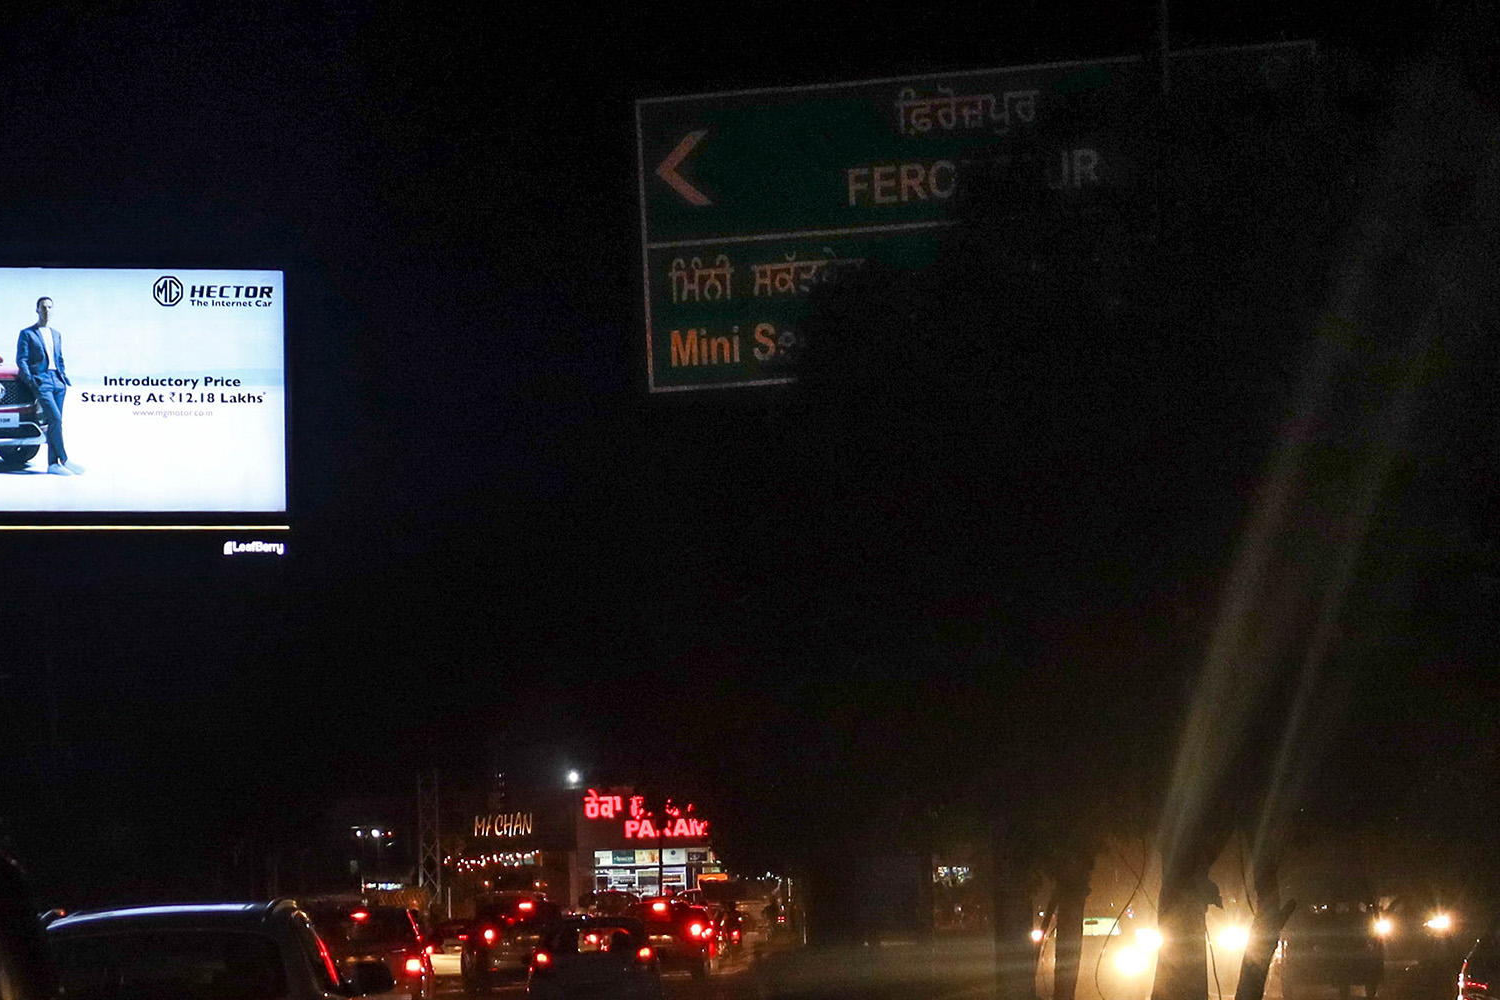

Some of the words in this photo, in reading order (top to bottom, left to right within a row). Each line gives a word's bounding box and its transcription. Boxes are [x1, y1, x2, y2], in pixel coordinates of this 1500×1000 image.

[156, 279, 181, 303] MG
[190, 285, 274, 299] HECTOR
[190, 299, 209, 307] The
[211, 299, 252, 307] Internet
[255, 299, 273, 307] Car
[670, 325, 741, 368] Mini
[103, 375, 198, 390] Introductory
[203, 376, 241, 387] Price
[81, 392, 142, 406] Starting
[146, 392, 164, 403] At
[169, 391, 215, 404] ₹12.18
